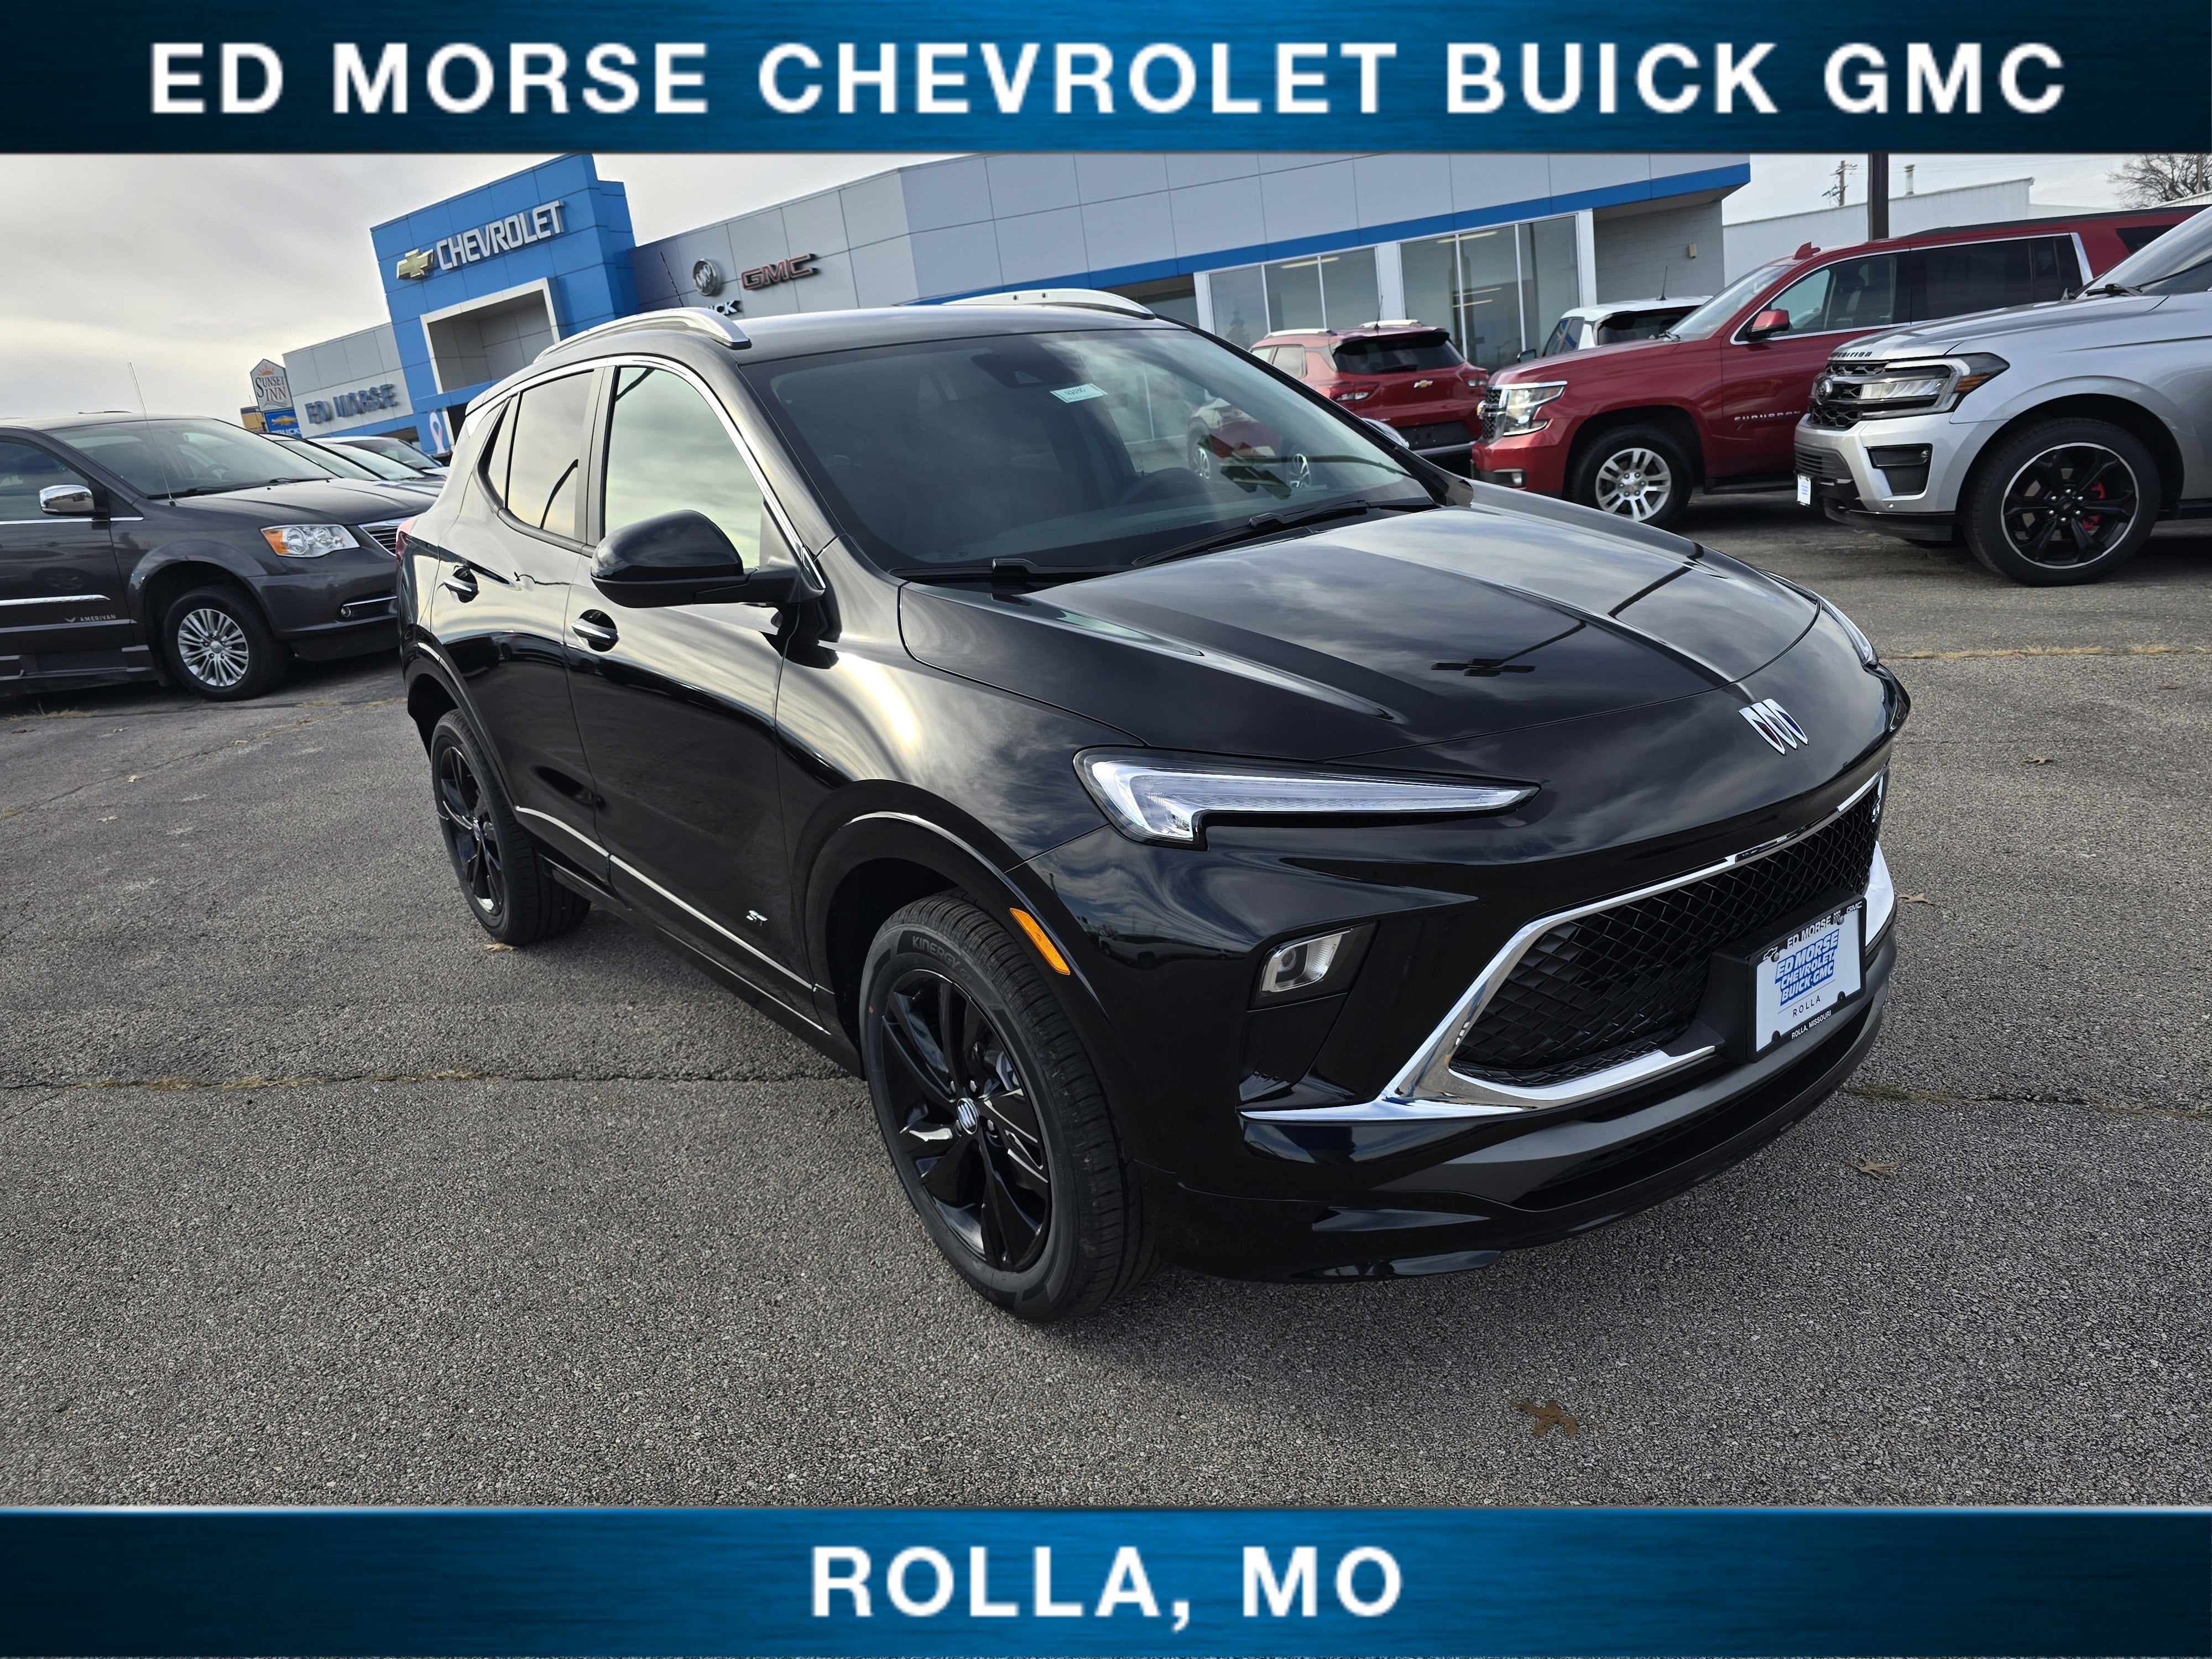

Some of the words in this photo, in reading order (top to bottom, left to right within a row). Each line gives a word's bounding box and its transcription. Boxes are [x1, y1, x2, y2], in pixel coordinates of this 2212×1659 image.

[436, 200, 563, 270] CHEVROLET
[741, 254, 815, 290] GMC
[255, 377, 285, 398] SUNSET
[265, 387, 286, 401] INN
[305, 400, 330, 424] ED
[333, 383, 397, 418] MORSE
[1846, 901, 1863, 914] GMC
[1787, 933, 1799, 948] ED
[1801, 915, 1832, 941] MORSE
[913, 936, 961, 968] KINERGY
[1775, 956, 1795, 980] ED
[1794, 930, 1839, 969] MORSE
[1793, 995, 1821, 1018] ROLLA
[1791, 1026, 1808, 1040] ROLLA,
[1809, 1010, 1832, 1029] MISSOURI
